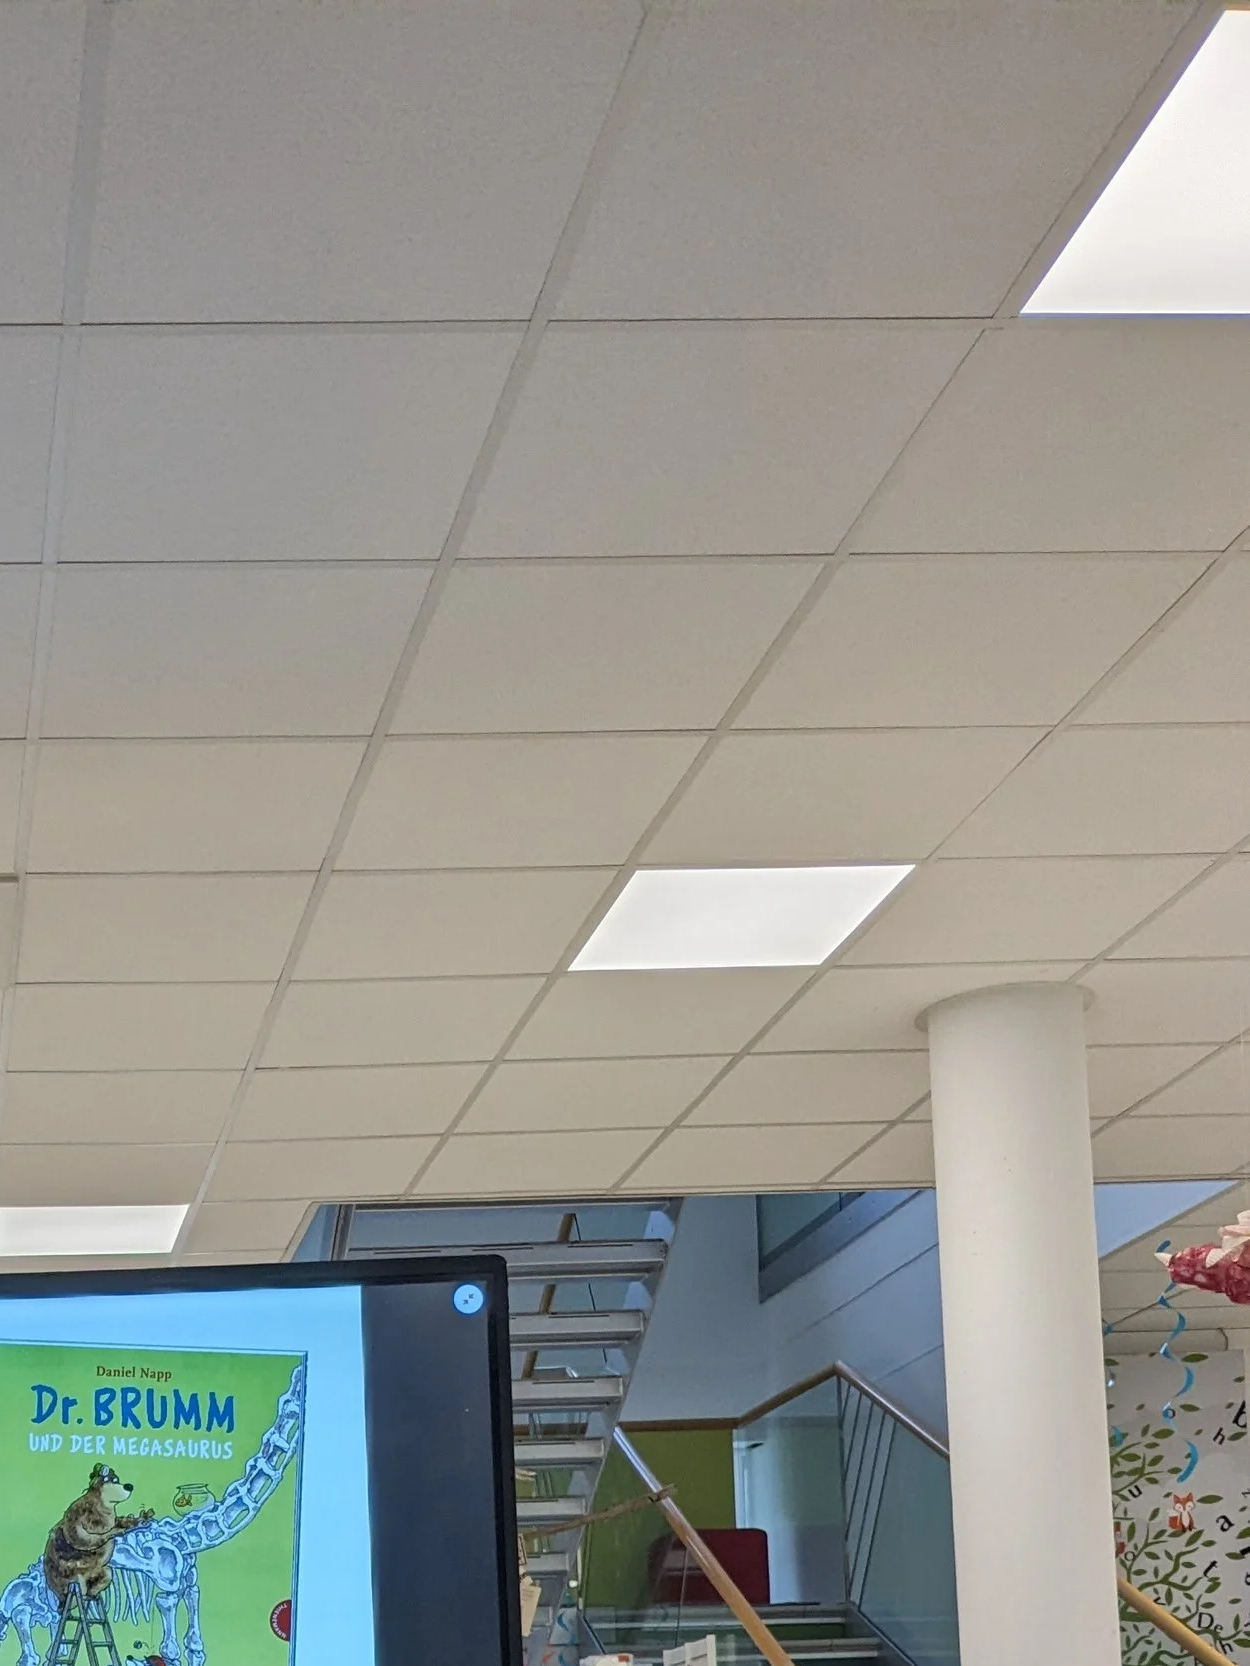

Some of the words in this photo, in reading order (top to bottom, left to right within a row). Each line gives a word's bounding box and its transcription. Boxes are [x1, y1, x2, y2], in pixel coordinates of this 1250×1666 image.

[96, 1365, 136, 1378] Daniel
[140, 1367, 172, 1382] Napp
[31, 1384, 84, 1425] Dr.
[94, 1386, 235, 1434] BRUMM
[29, 1432, 63, 1453] UND
[69, 1434, 106, 1456] DER
[112, 1436, 234, 1460] MEGASAURUS
